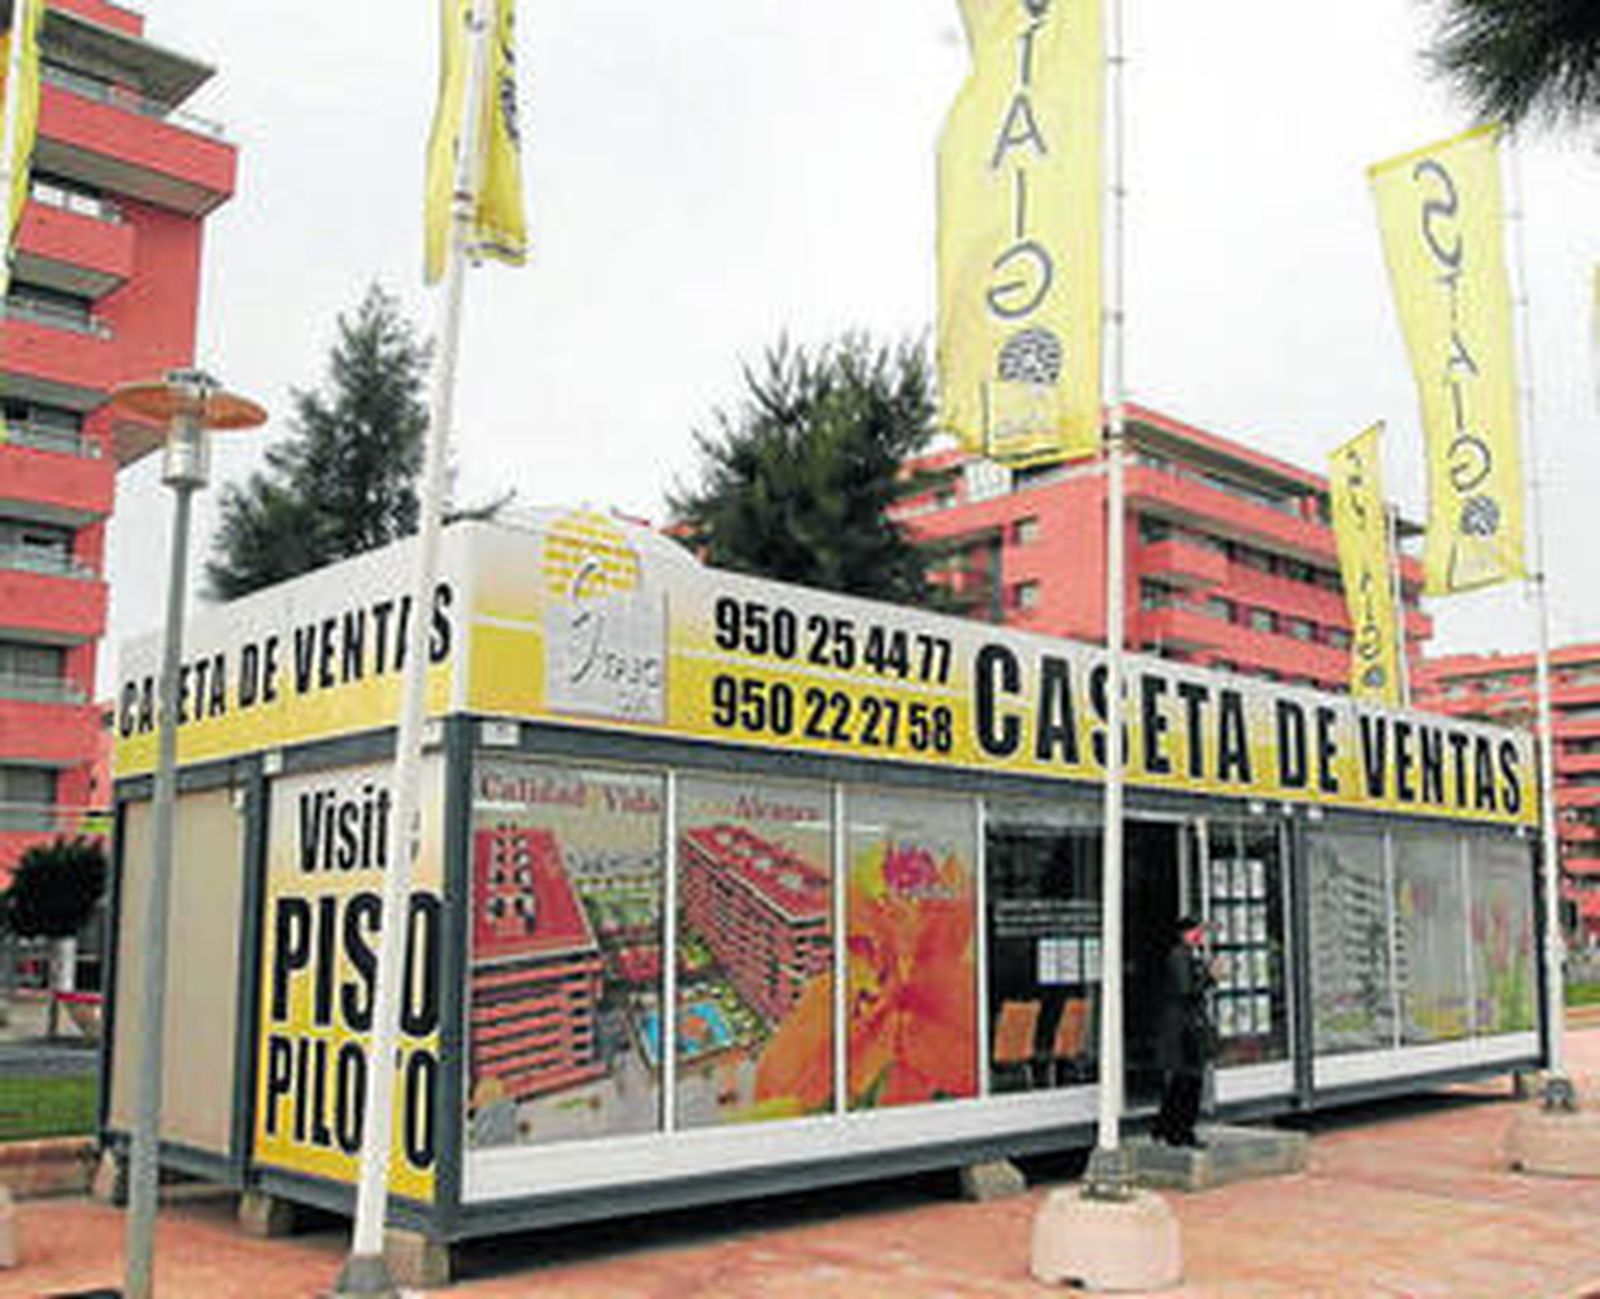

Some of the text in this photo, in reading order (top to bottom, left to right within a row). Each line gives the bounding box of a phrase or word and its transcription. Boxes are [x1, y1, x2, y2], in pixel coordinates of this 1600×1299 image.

[119, 654, 227, 739] CAETA
[239, 636, 279, 708] DE
[715, 597, 797, 660] 950
[808, 614, 855, 671] 25
[864, 626, 910, 678] 44
[917, 634, 952, 684] 77
[712, 673, 794, 736] 950
[803, 687, 852, 742] 22
[860, 695, 900, 748] 27
[908, 702, 953, 754] 58
[974, 643, 1520, 815] CASETA DE VENTAS
[299, 785, 420, 873] Visit
[270, 890, 442, 1038] PISO
[265, 1033, 438, 1170] PILOO
